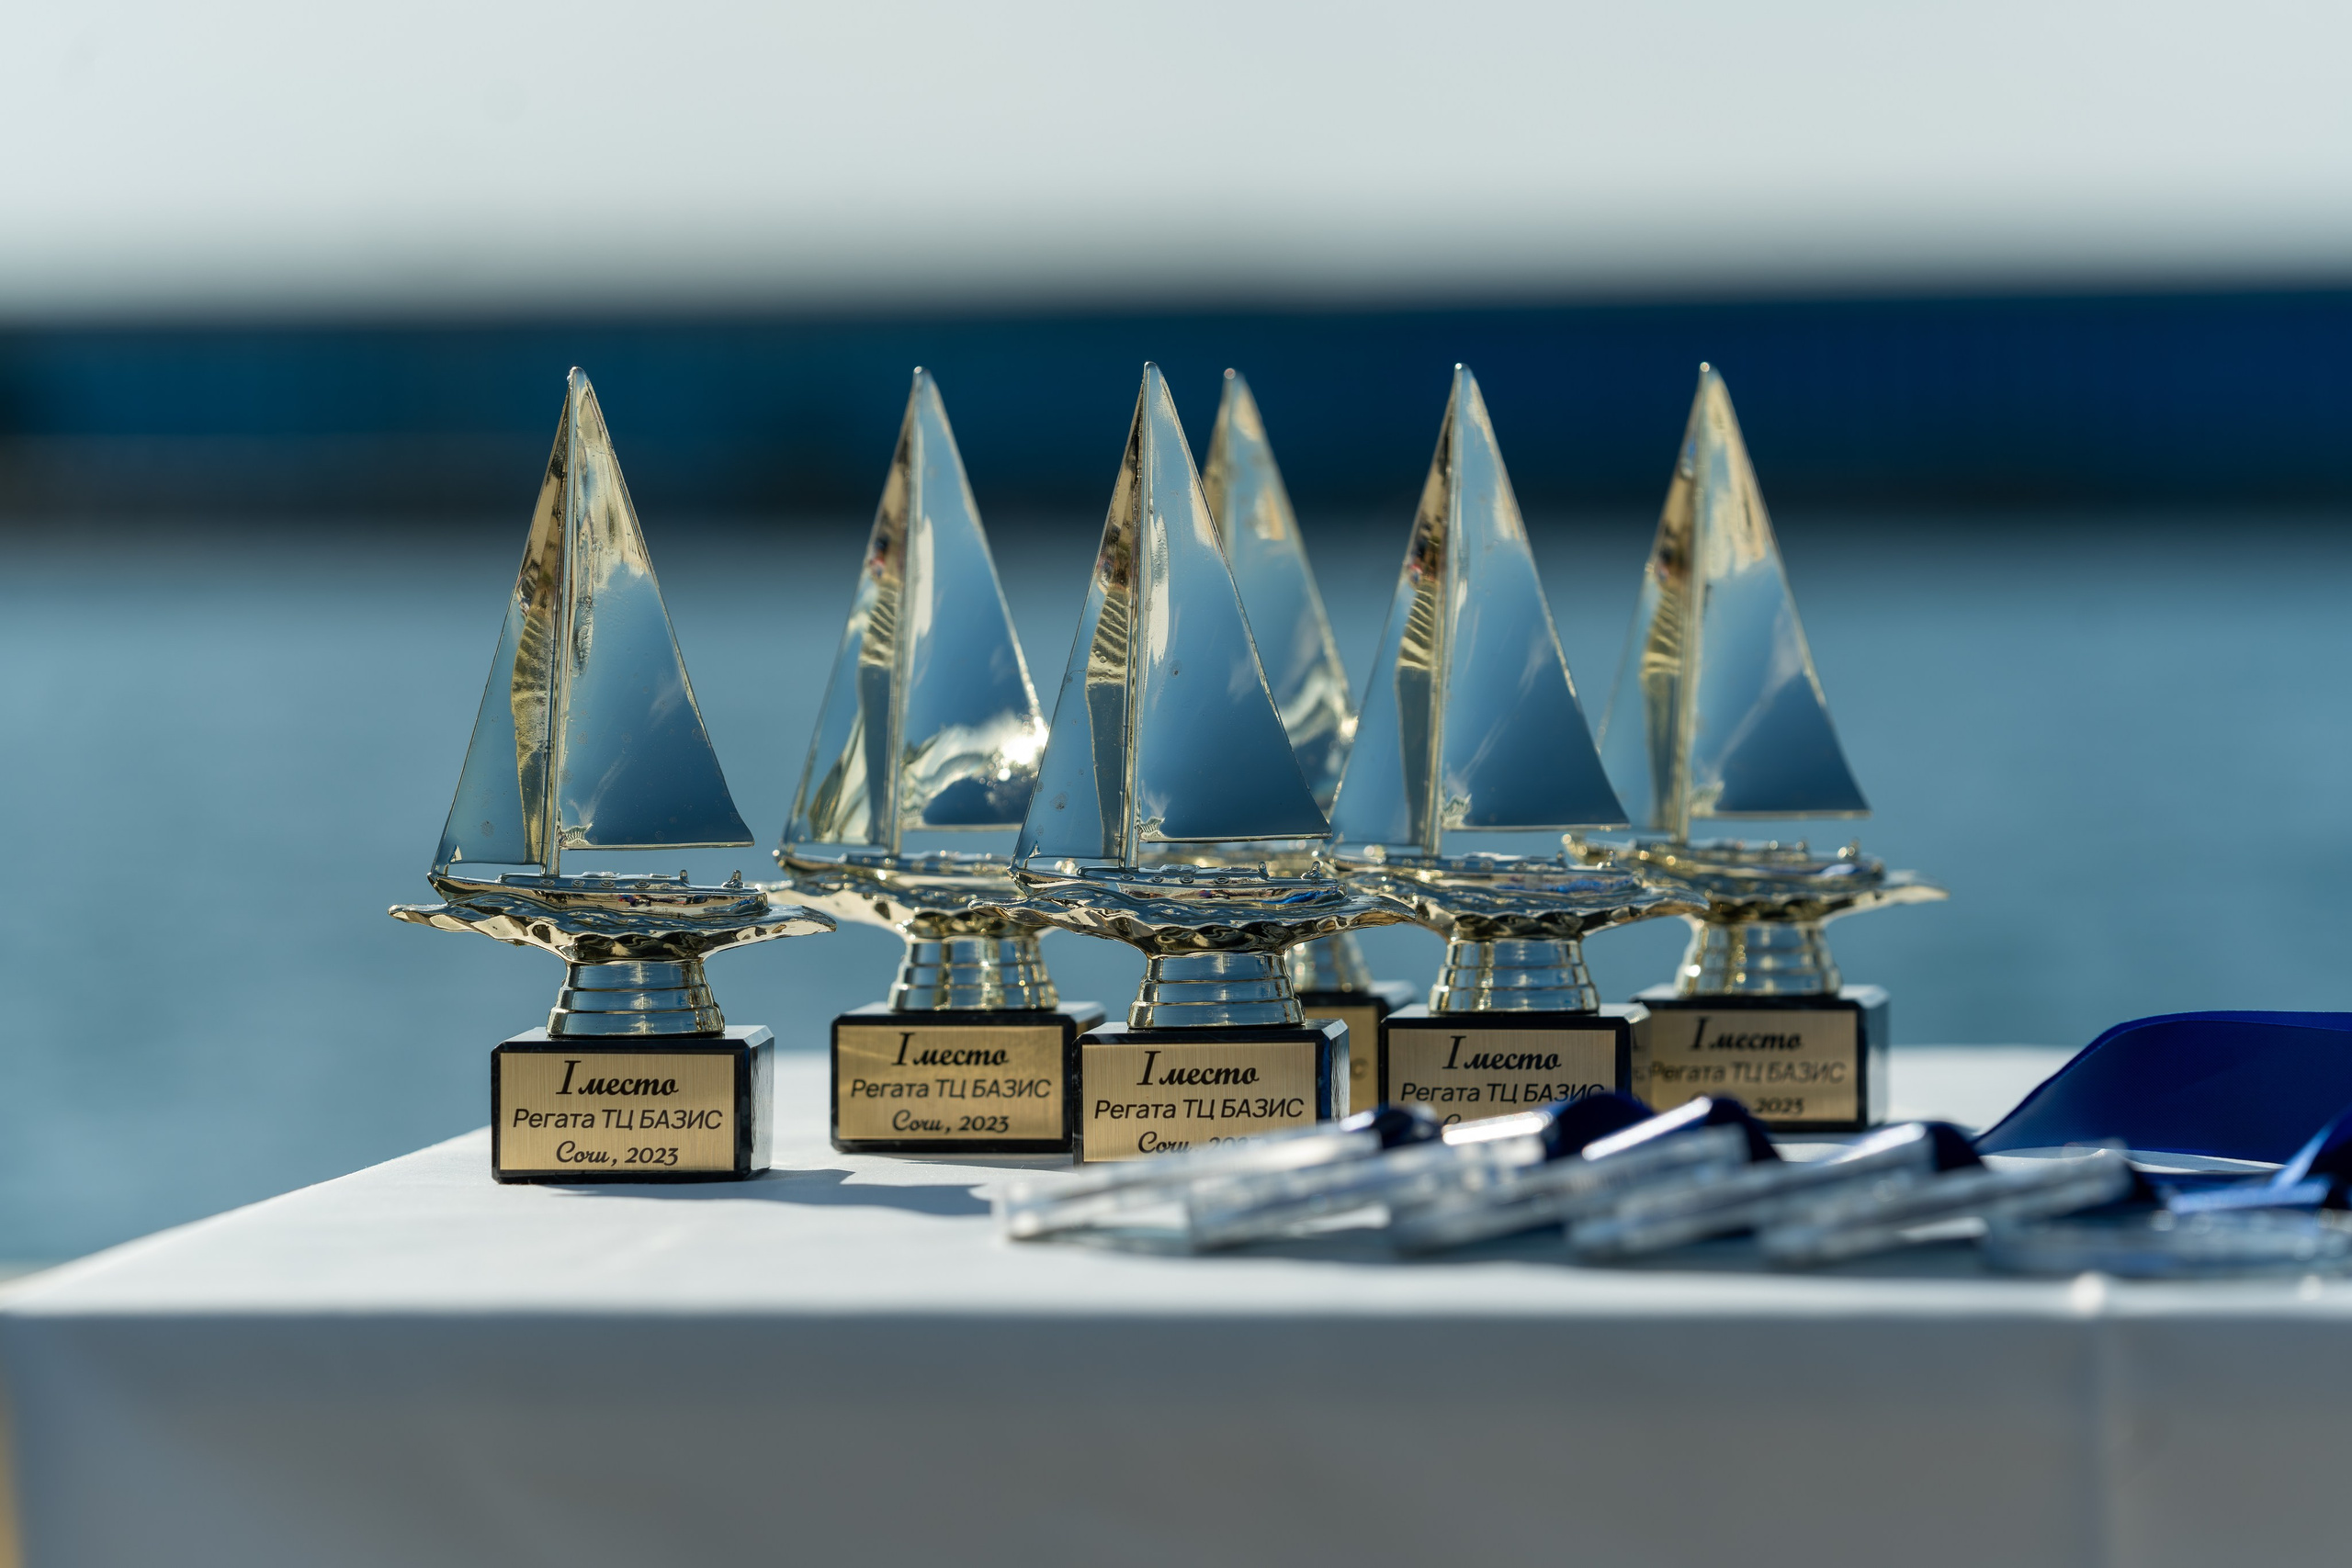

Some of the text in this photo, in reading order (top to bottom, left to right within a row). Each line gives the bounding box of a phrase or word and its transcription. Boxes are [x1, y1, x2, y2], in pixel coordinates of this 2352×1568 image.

[1689, 1016, 1804, 1051] I место
[891, 1032, 1010, 1066] I место
[1442, 1035, 1562, 1070] I место
[556, 1060, 679, 1096] I место
[1136, 1051, 1260, 1086] I место
[1650, 1061, 1847, 1084] Регата ТЦ БАЗИС
[851, 1079, 1051, 1100] Регата ТЦ БАЗИС
[1400, 1082, 1480, 1101] Регата
[1487, 1083, 1518, 1104] ТЦ
[513, 1109, 723, 1131] Регата ТЦ БАЗИС
[1094, 1098, 1305, 1120] Регата ТЦ БАЗИС
[892, 1110, 1010, 1134] Сочи, 2023
[556, 1140, 679, 1167] Сочи, 2023
[1137, 1131, 1199, 1154] Сочи
